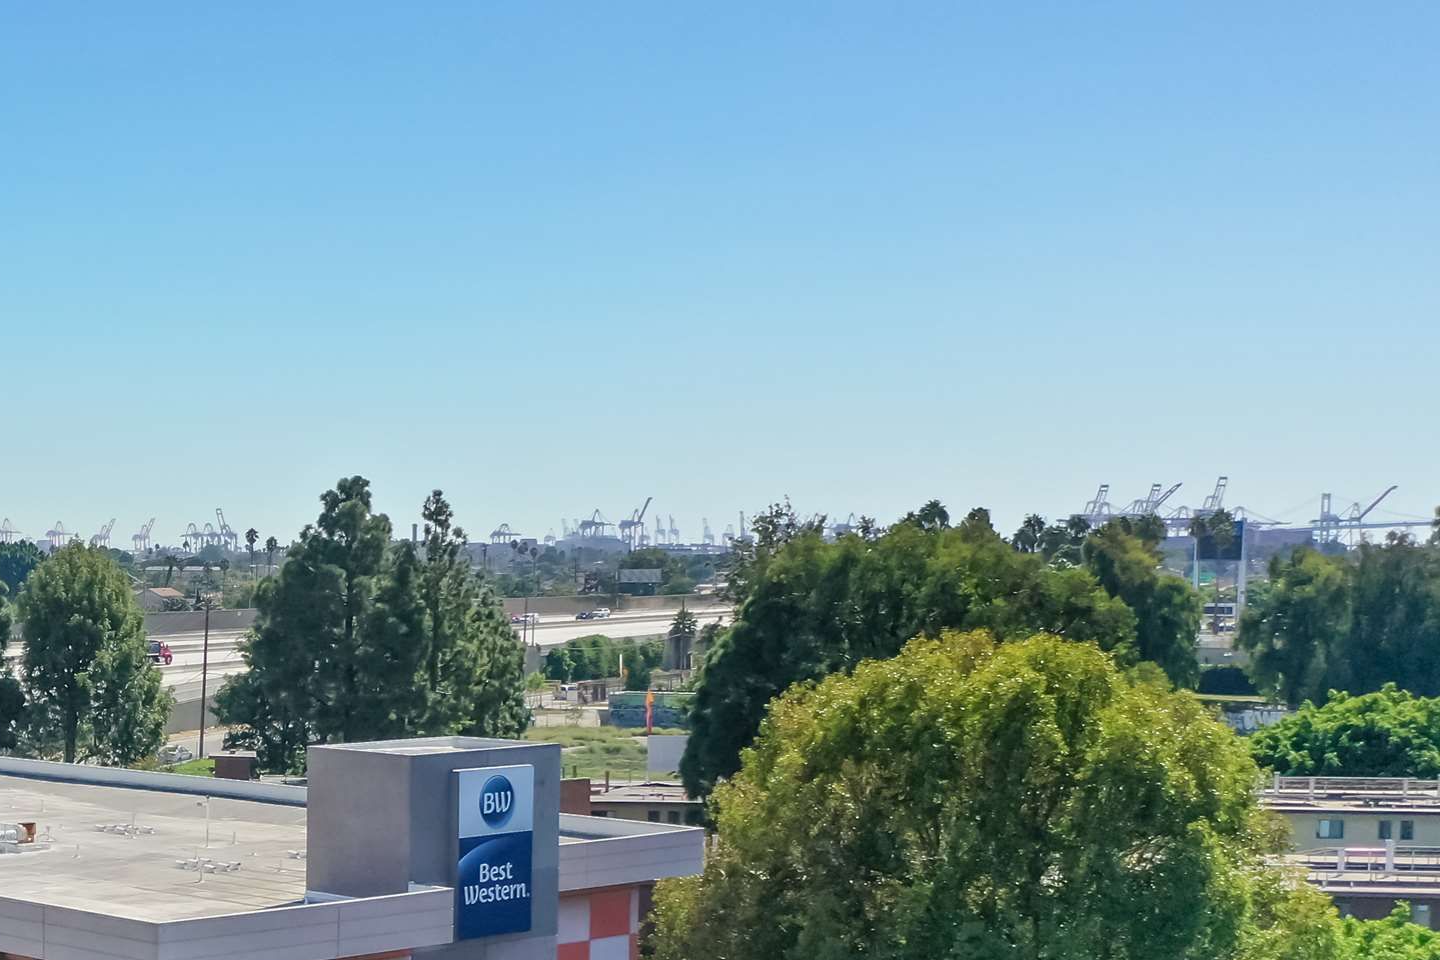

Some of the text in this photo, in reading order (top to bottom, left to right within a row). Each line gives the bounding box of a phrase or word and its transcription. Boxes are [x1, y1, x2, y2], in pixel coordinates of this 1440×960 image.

[483, 791, 511, 814] BW
[479, 862, 513, 882] Best
[464, 883, 526, 905] Western
